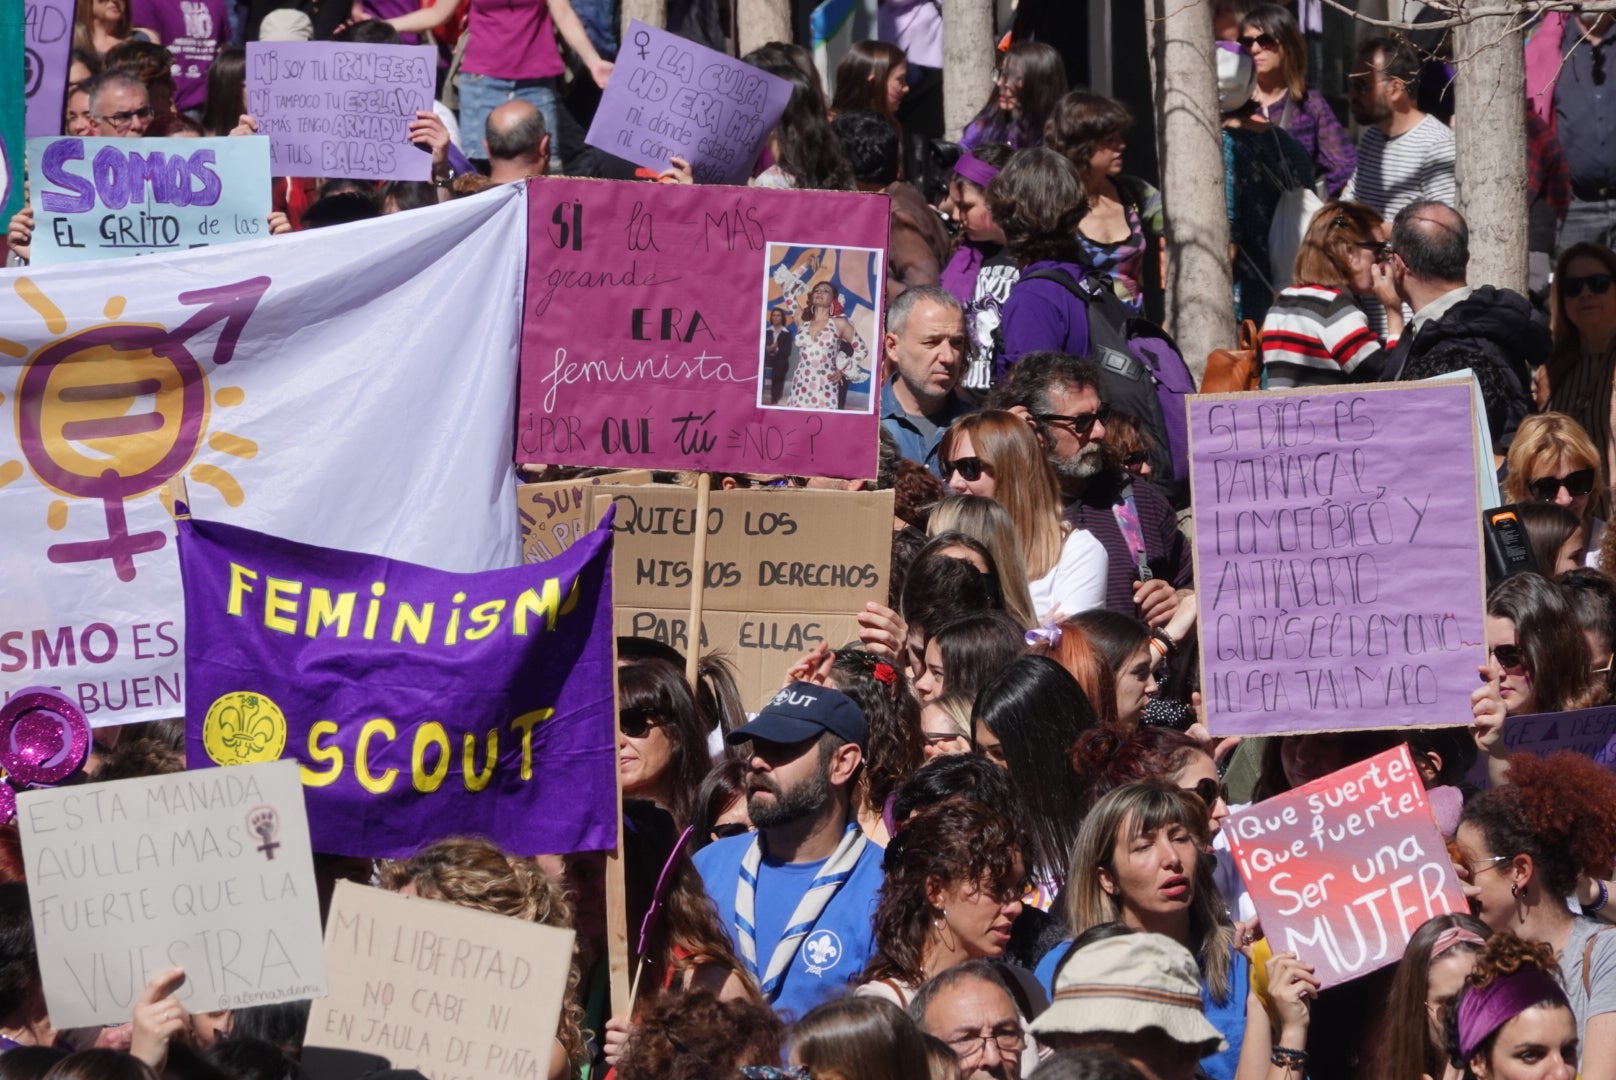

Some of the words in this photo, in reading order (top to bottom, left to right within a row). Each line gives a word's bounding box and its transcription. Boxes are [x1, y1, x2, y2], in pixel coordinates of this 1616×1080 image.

[282, 59, 306, 80] SOY
[311, 60, 328, 81] TU
[657, 45, 694, 83] LA
[698, 64, 769, 114] CULPA
[258, 114, 292, 133] DEMÁS
[297, 117, 331, 133] TENGO
[274, 95, 320, 110] TAMPOCO
[324, 93, 340, 110] TU
[344, 88, 424, 116] ESCLAVA
[628, 68, 668, 102] NO
[670, 87, 724, 134] ERA
[284, 144, 312, 165] TUS
[321, 141, 397, 174] BALAS
[617, 130, 632, 148] ni
[626, 107, 644, 126] ni
[648, 111, 692, 145] dónde
[698, 136, 735, 165] estaba
[41, 138, 222, 213] SOMOS
[53, 217, 86, 248] EL
[199, 215, 220, 235] de
[235, 216, 260, 234] las
[624, 201, 660, 252] la
[705, 197, 766, 252] MÁS
[536, 259, 682, 317] grande
[632, 308, 716, 343] ERA
[540, 347, 759, 413] feminista
[520, 412, 587, 454] ¿POR
[601, 406, 656, 455] QUÉ
[671, 410, 717, 456] tú
[744, 511, 798, 536] LOS
[1403, 493, 1432, 544] Y
[636, 558, 742, 589] MISOS
[758, 561, 879, 588] DERECHOS
[132, 621, 179, 660] ES
[738, 621, 824, 652] ELLAS
[1214, 669, 1243, 714] NO
[1294, 667, 1350, 711] TAN
[299, 706, 556, 796] SCOUT
[28, 789, 128, 834] ESTA
[146, 775, 264, 817] MANADA
[1226, 805, 1299, 848] ¡Que
[1307, 746, 1415, 815] suerte!
[171, 825, 244, 866] MAS
[1238, 838, 1308, 881] ¡Que
[1309, 781, 1425, 852] fuerte!
[1269, 871, 1336, 917] Ser
[1351, 834, 1427, 884] una
[38, 888, 156, 936] FUERTE
[172, 877, 243, 917] QUE
[259, 872, 299, 901] LA
[1284, 862, 1452, 975] MUJER
[332, 909, 376, 957] MI
[392, 925, 532, 990] LIBERTAD
[362, 980, 396, 1018] NO
[411, 987, 468, 1026] CABE
[487, 1004, 511, 1035] NI
[324, 1008, 355, 1042] EN
[360, 1017, 432, 1055] JAULA
[446, 1036, 475, 1068] DE
